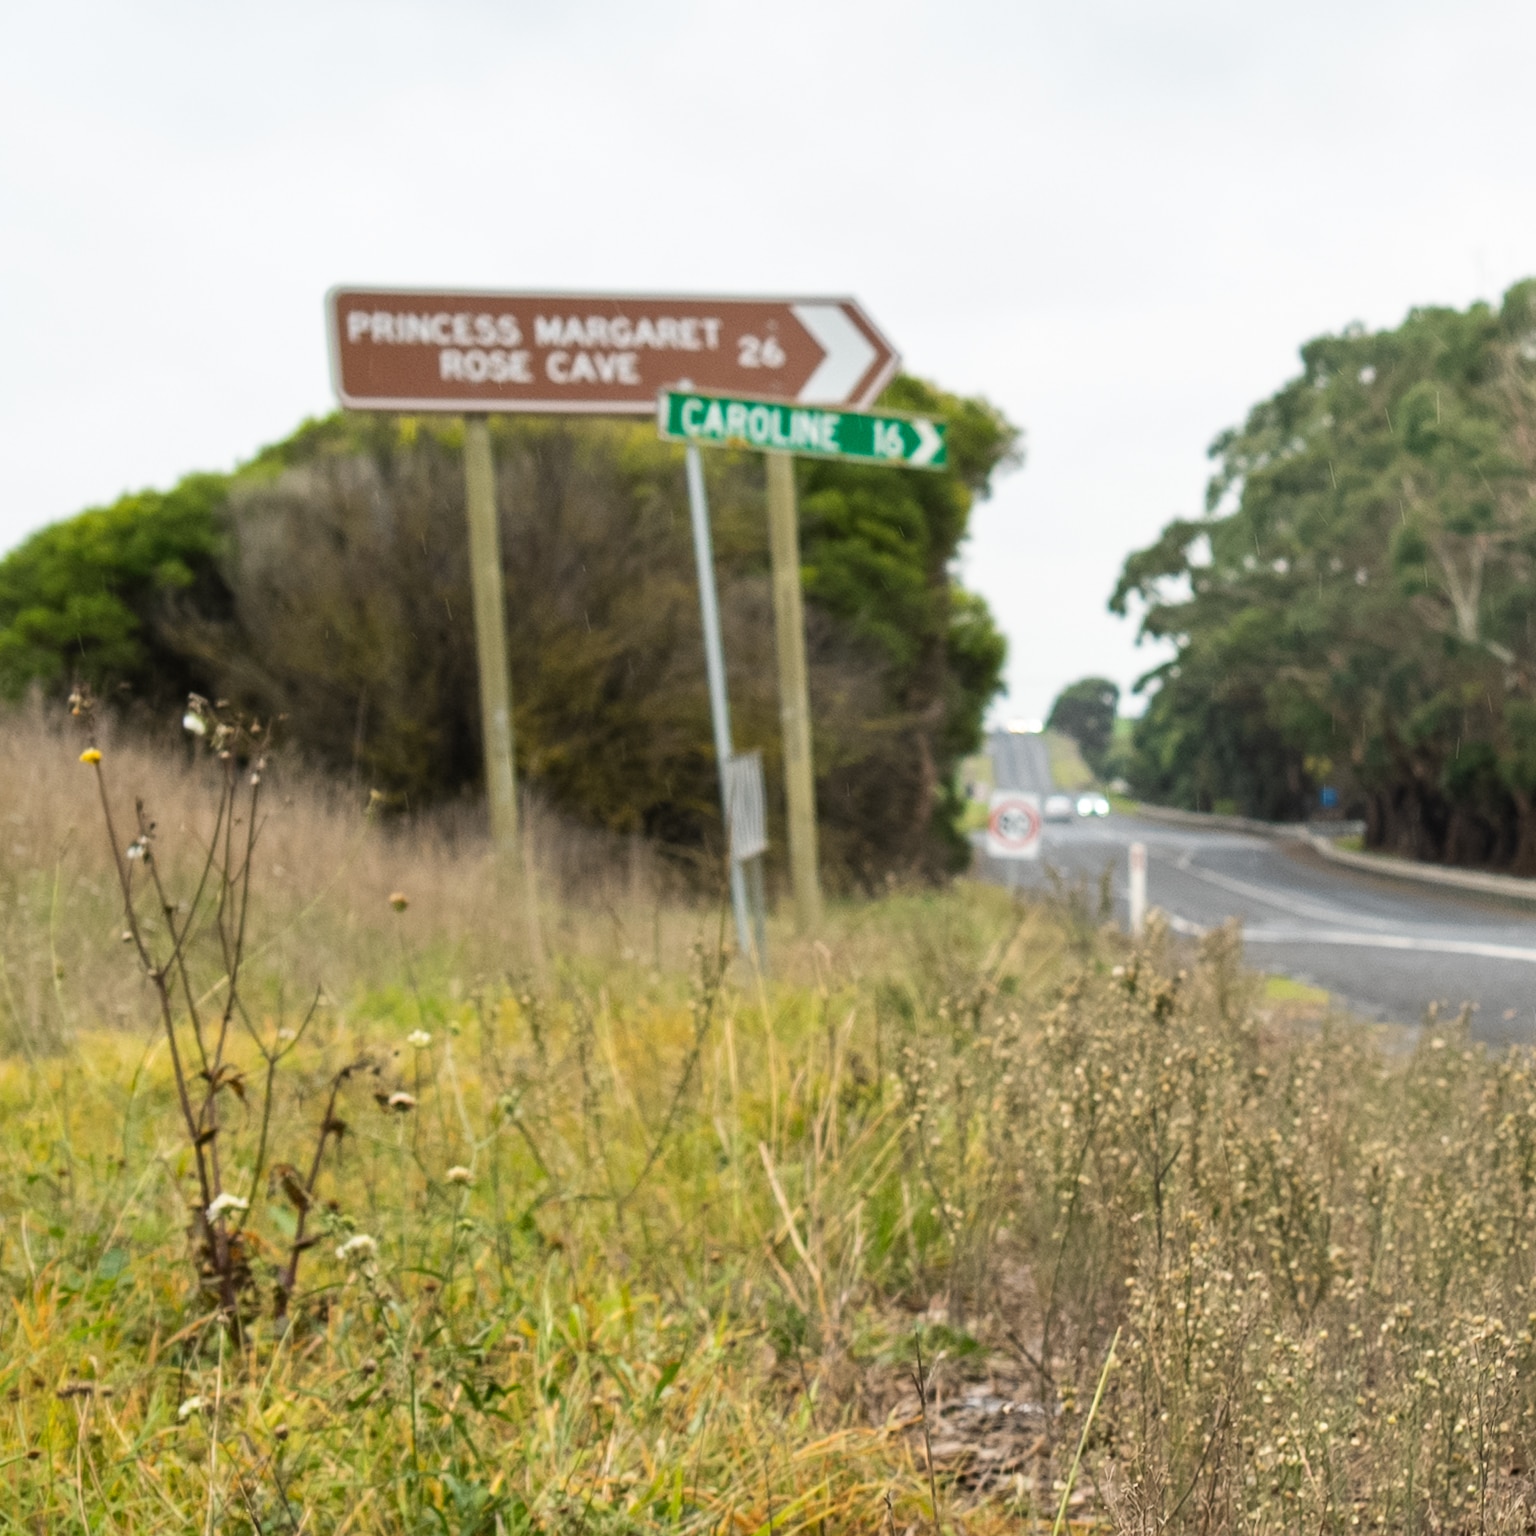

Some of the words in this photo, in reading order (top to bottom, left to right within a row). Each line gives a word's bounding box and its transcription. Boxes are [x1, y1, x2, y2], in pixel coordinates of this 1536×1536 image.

[347, 310, 523, 347] PRINCESS
[533, 313, 722, 350] MARGARET
[438, 349, 535, 384] ROSE
[545, 352, 642, 386] CAVE
[737, 333, 787, 369] 26
[680, 397, 841, 452] CAROLINE
[873, 418, 906, 457] 16
